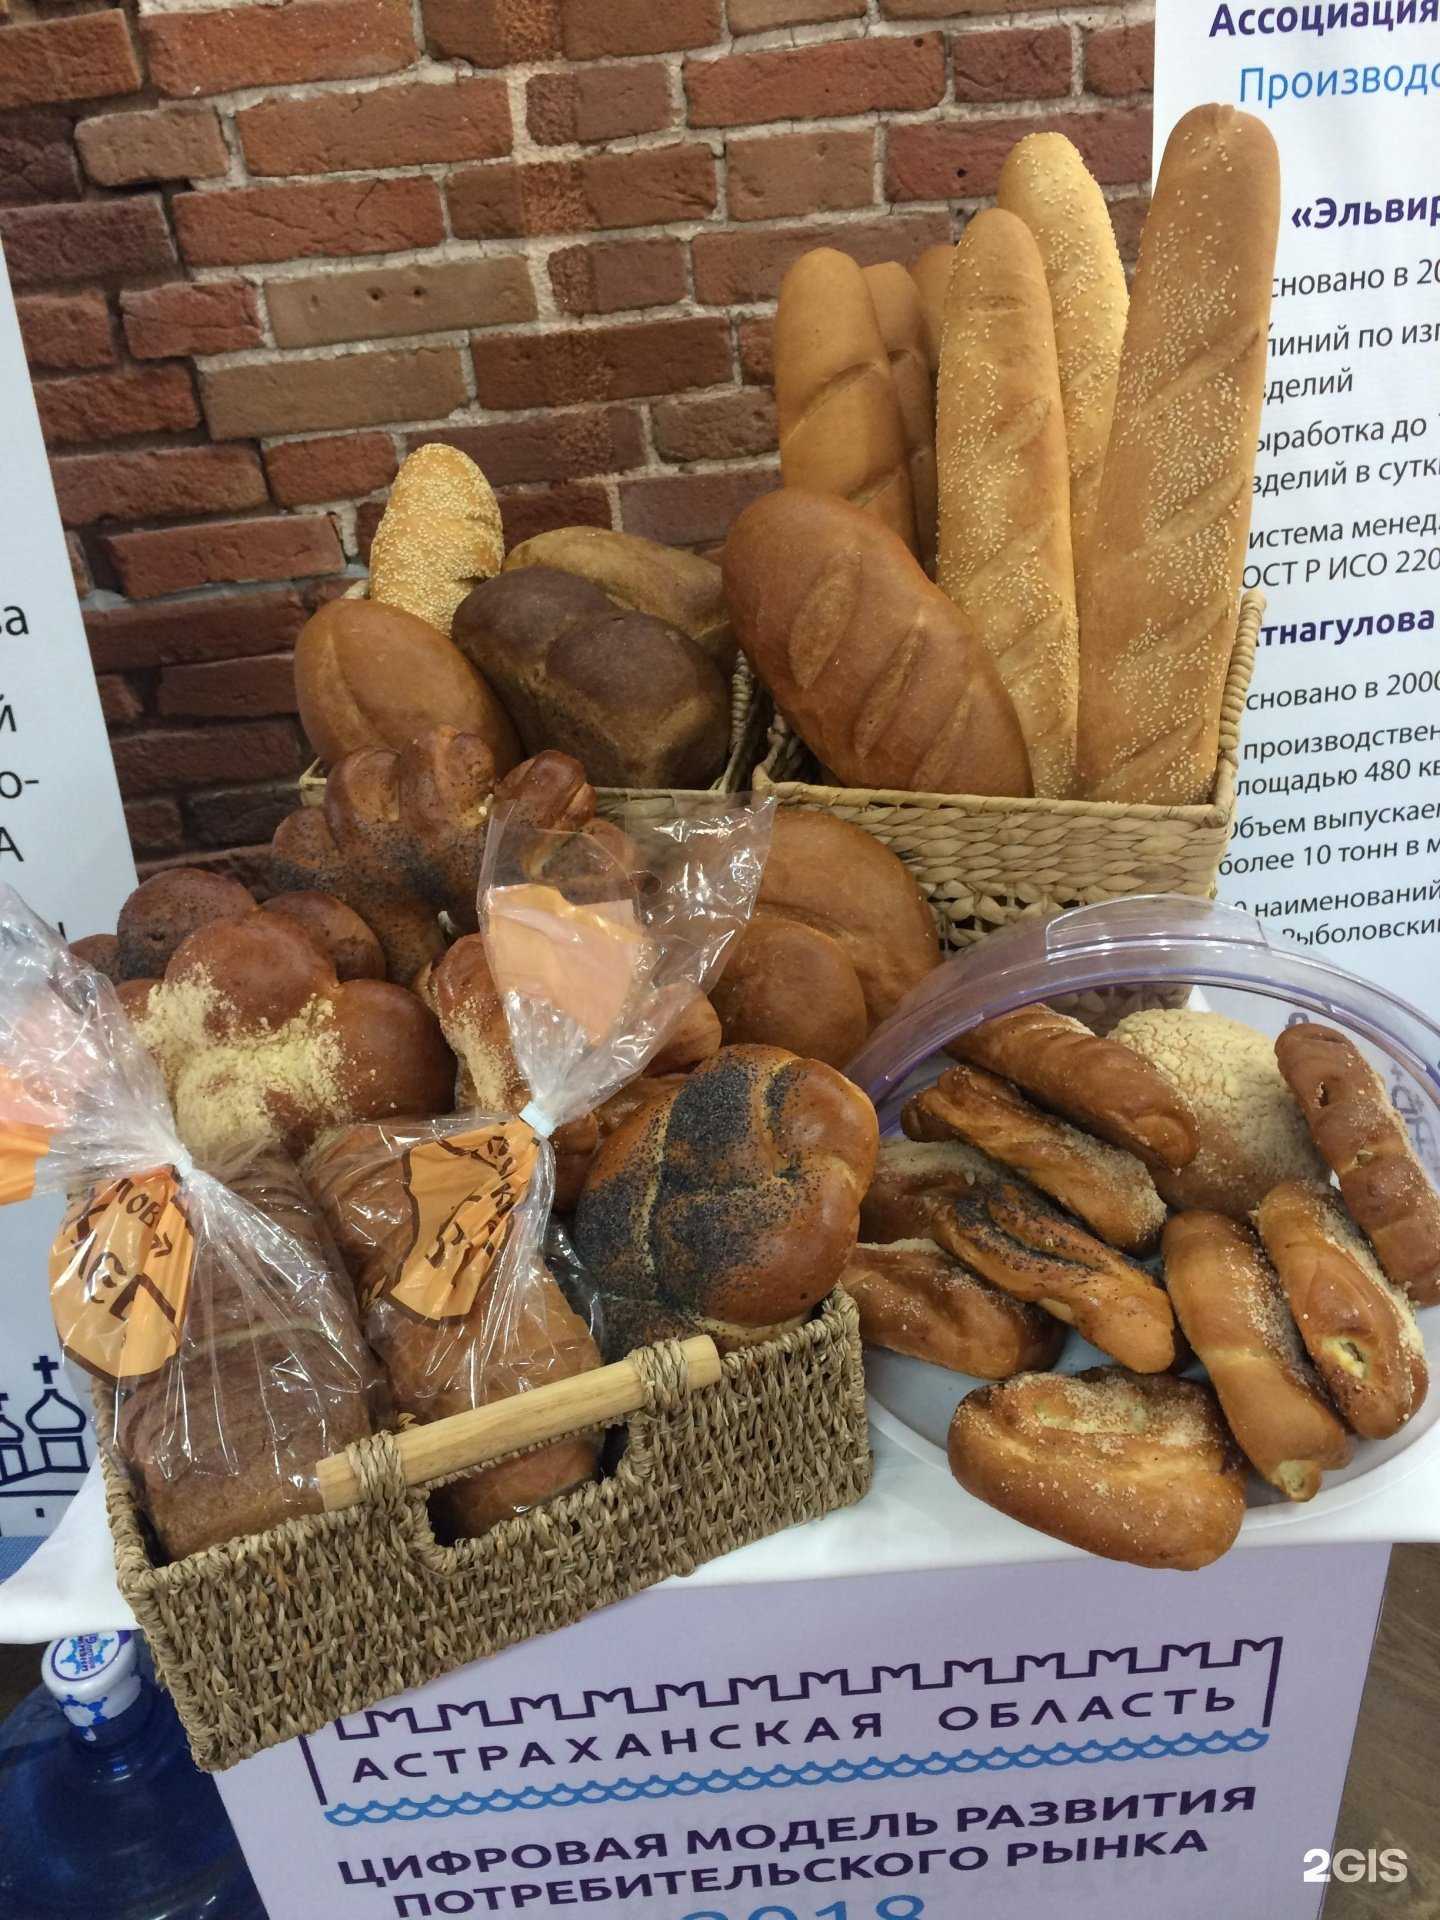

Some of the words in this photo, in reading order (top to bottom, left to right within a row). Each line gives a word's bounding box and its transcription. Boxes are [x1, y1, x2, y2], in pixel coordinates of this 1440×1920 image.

[1209, 0, 1439, 37] Ассоциация
[1272, 267, 1385, 298] новано
[1394, 267, 1408, 287] в
[1359, 327, 1393, 349] по
[1264, 369, 1352, 406] делий
[1256, 420, 1384, 457] ыработка
[1392, 417, 1427, 444] до
[1252, 461, 1347, 497] зделий
[1356, 465, 1370, 483] в
[1379, 457, 1440, 487] сутк
[1249, 522, 1343, 549] истема
[1352, 512, 1440, 538] менед
[1242, 561, 1298, 589] ОСТ
[1305, 558, 1321, 582] Р
[1329, 551, 1388, 580] ИСО
[1256, 608, 1435, 646] тнагулова
[1246, 683, 1357, 710] сновано
[1365, 681, 1378, 698] в
[1236, 768, 1357, 797] лощадью
[1364, 758, 1411, 782] 480
[1313, 803, 1440, 831] выпускае
[1218, 852, 1294, 876] более
[1304, 844, 1331, 866] 10
[1338, 842, 1398, 862] тонн
[1406, 839, 1419, 856] в
[1255, 879, 1440, 917] наименований
[1282, 918, 1440, 946] ыболовски
[351, 1711, 883, 1784] АСТРАХАНСКАЯ
[938, 1685, 1236, 1733] ОБЛАСТЬ
[337, 1832, 668, 1888] ЦИФРОВАЯ
[685, 1810, 939, 1855] МОДЕЛЬ
[956, 1786, 1257, 1834] РАЗВИТИЯ
[393, 1846, 990, 1919] ПОТРЕБИТЕЛЬСКОГО
[1006, 1829, 1210, 1868] РЫНКА
